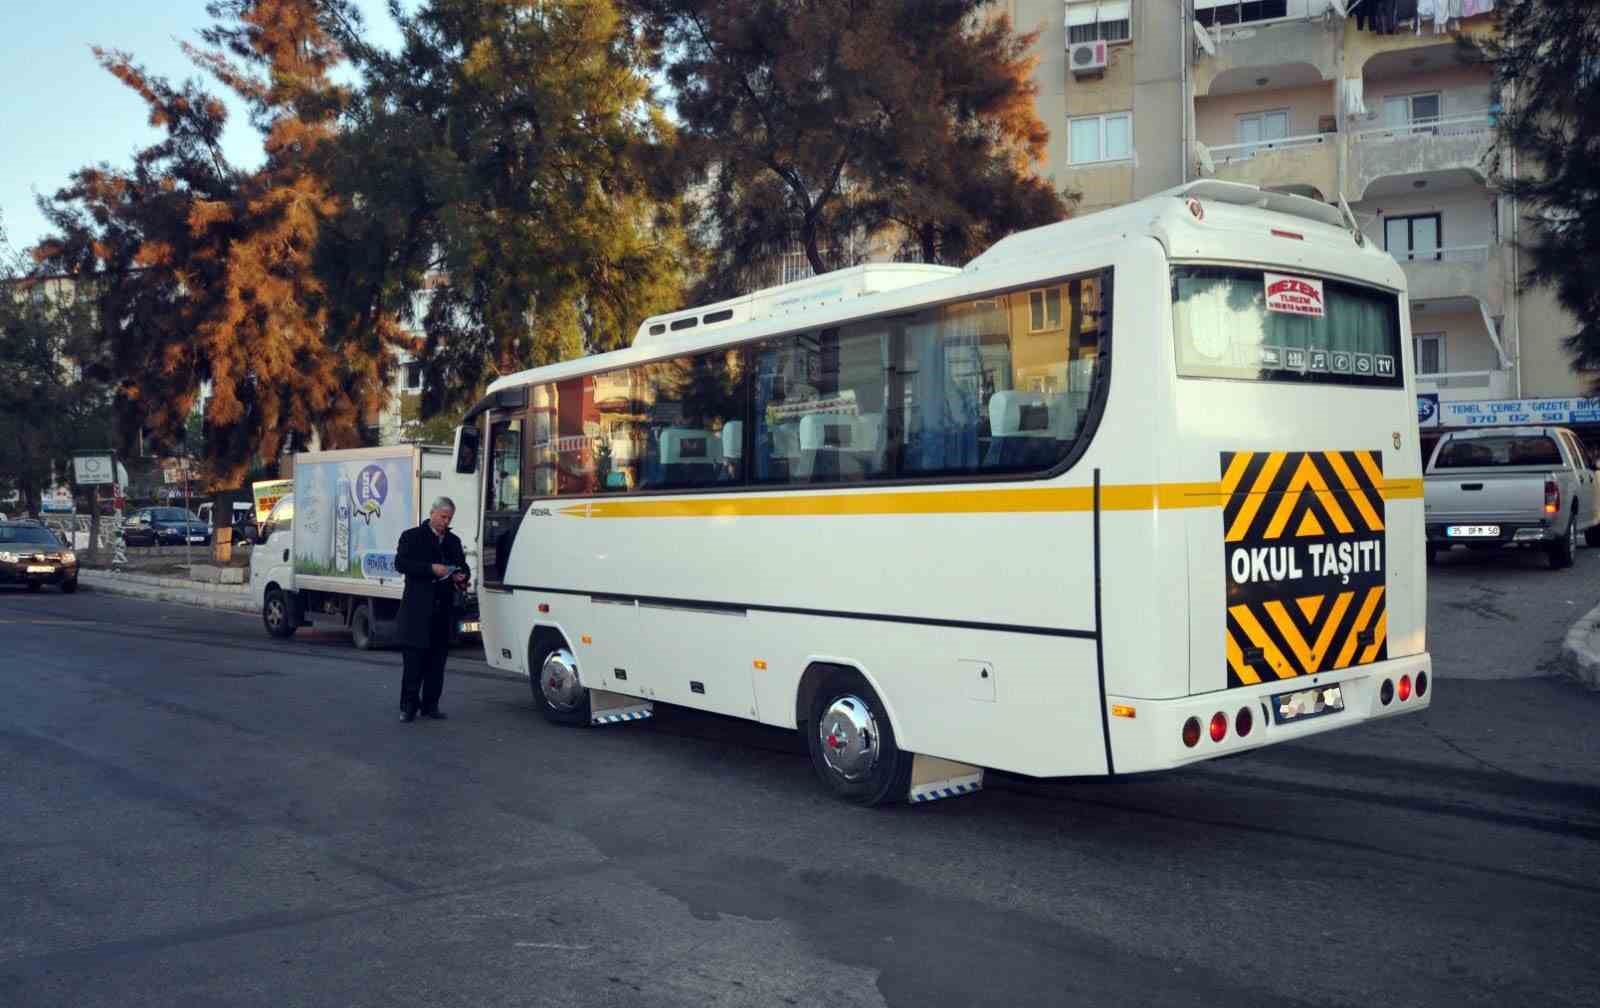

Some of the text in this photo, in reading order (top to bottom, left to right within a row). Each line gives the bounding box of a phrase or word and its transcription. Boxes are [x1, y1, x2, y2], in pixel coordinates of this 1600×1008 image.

[1378, 359, 1391, 372] TV
[1231, 540, 1380, 584] OKUL TAŞITI
